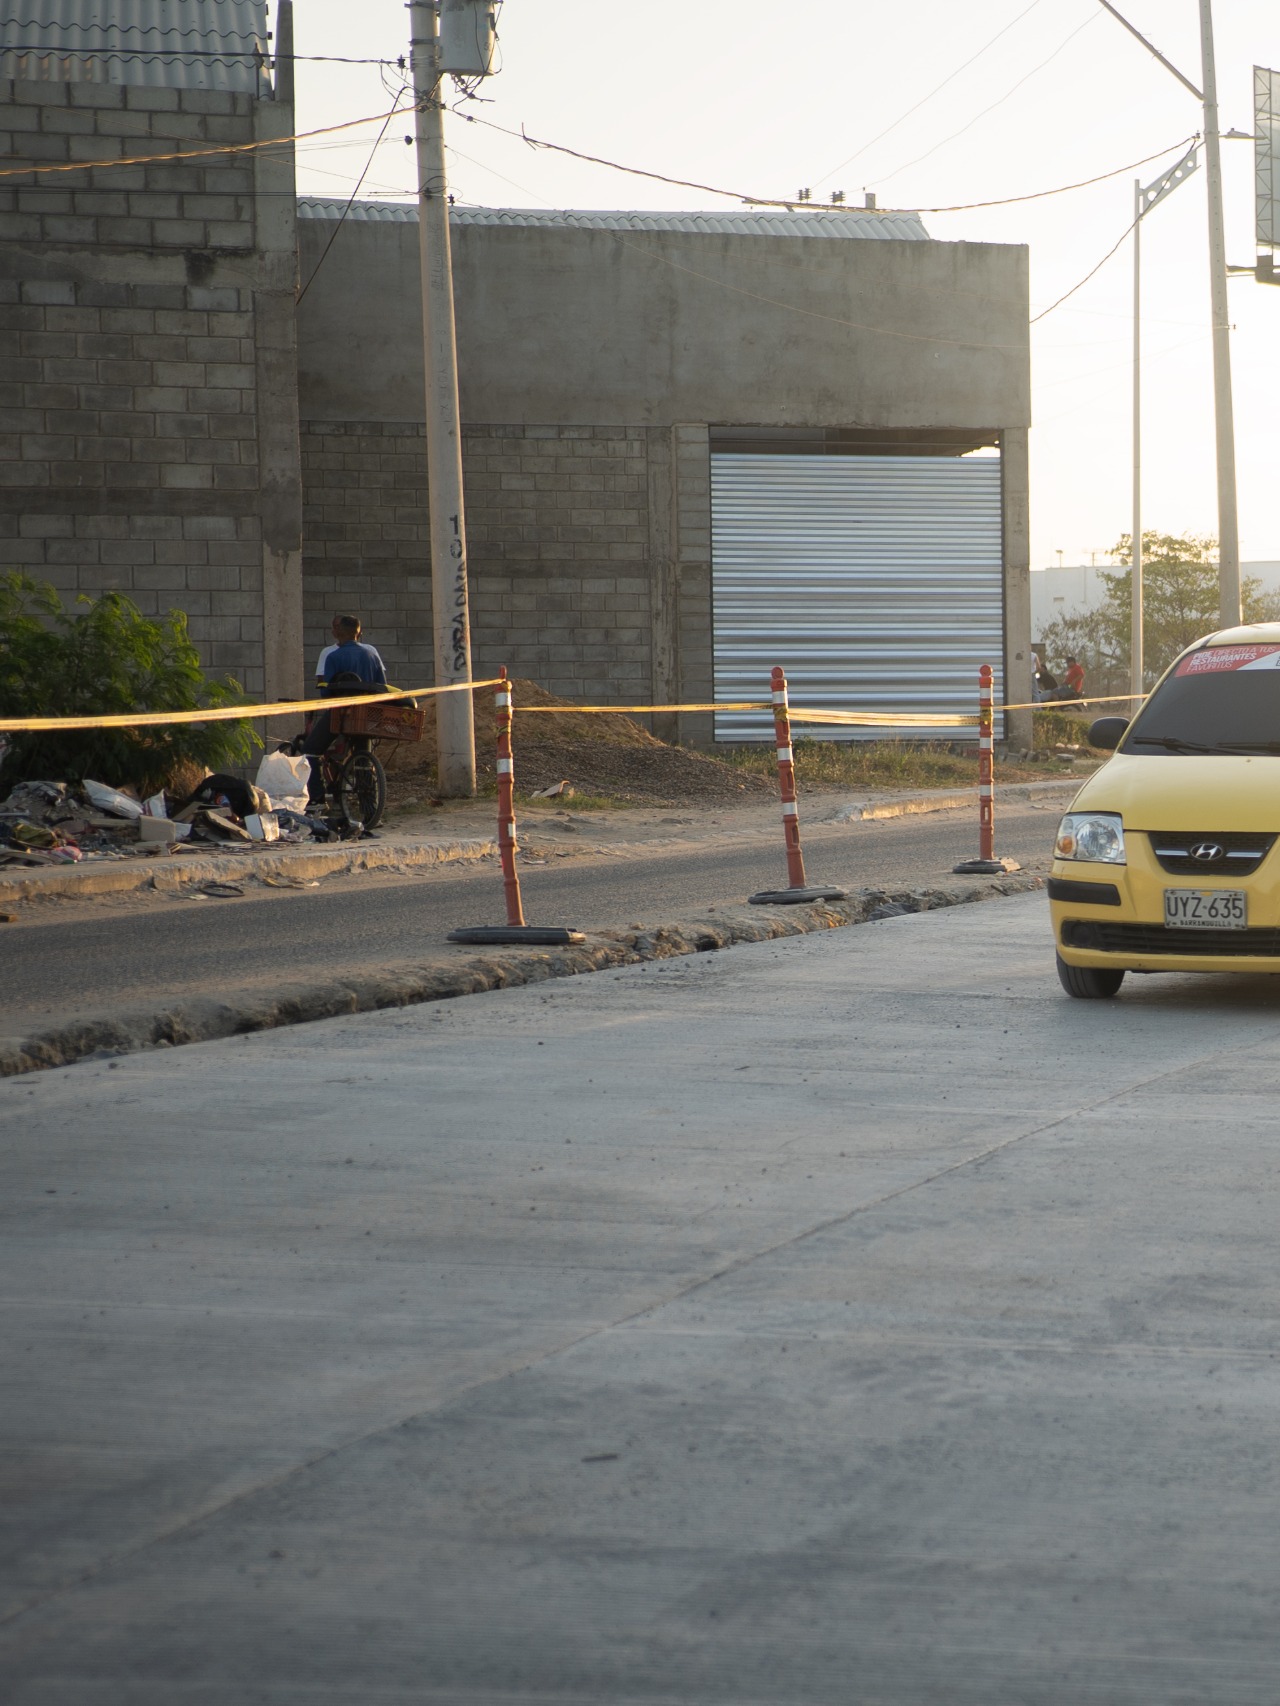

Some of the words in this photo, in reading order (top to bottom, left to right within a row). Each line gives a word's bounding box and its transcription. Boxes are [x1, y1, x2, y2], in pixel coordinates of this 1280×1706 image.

[1213, 647, 1250, 656] DIRECTO
[1190, 653, 1257, 666] RESTAURANTES
[1187, 661, 1233, 672] FAVORITOS
